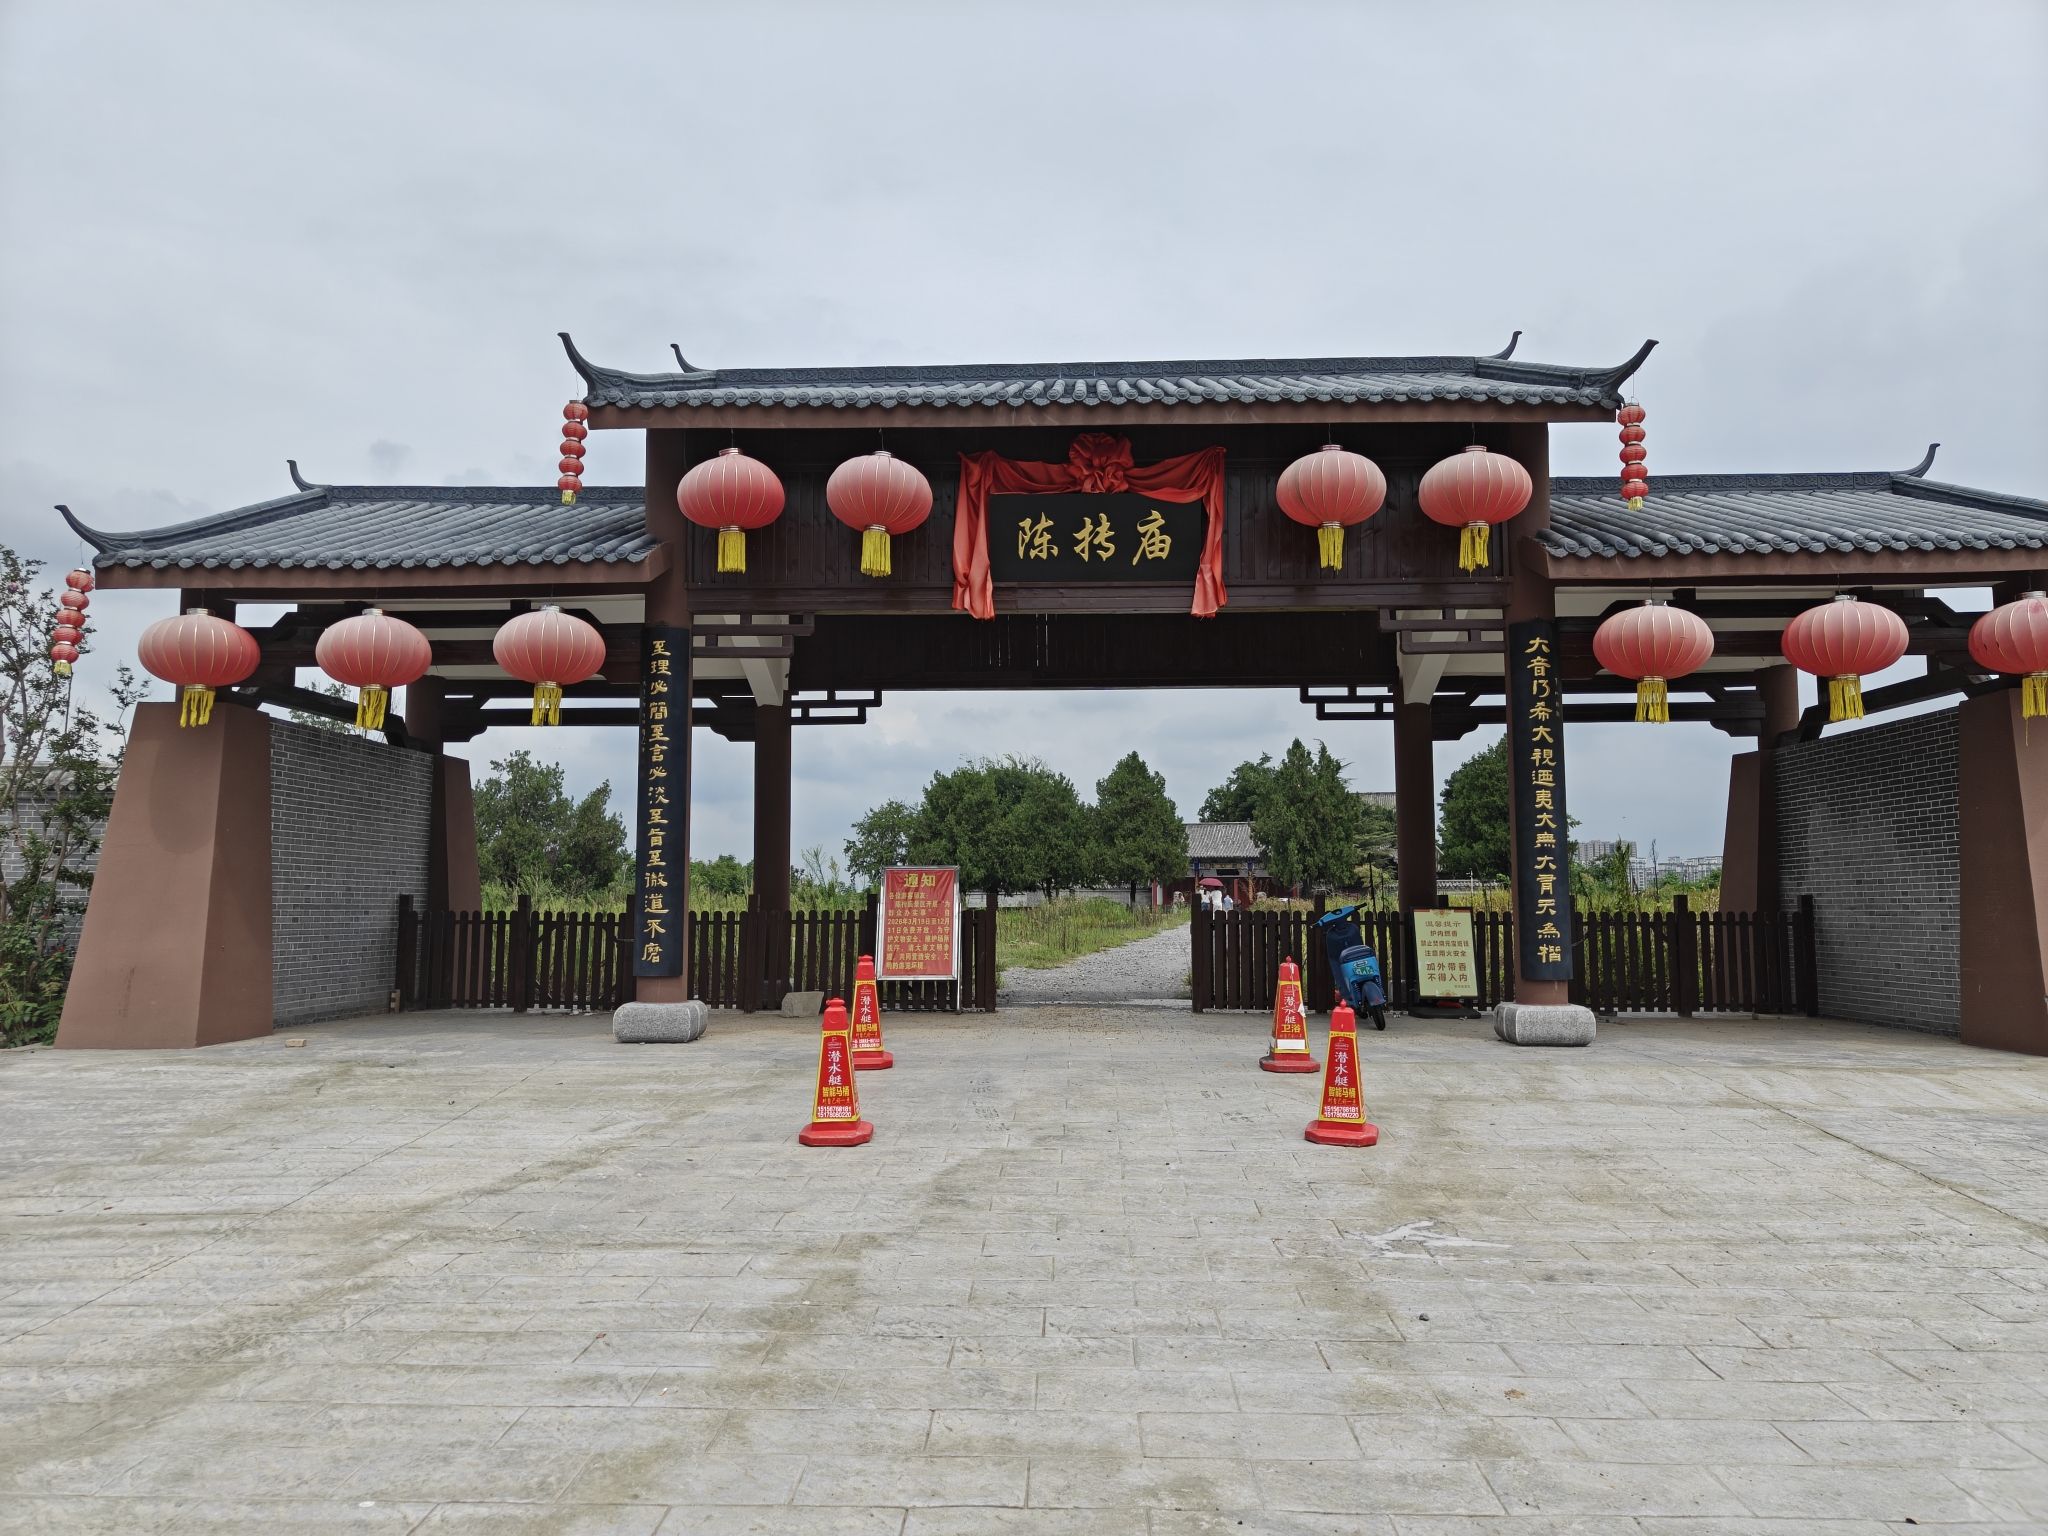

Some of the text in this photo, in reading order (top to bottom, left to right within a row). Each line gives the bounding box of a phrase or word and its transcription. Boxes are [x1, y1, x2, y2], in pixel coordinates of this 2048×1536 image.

[903, 873, 936, 888] 通知
[1424, 920, 1462, 928] 温馨提示
[1427, 973, 1468, 982] 不得入内
[860, 995, 873, 1023] 潜水艇
[1281, 1024, 1301, 1033] 卫浴
[827, 1050, 842, 1085] 潜水艇
[1334, 1051, 1349, 1087] 潜水艇
[822, 1085, 850, 1098] 智能马桶
[1328, 1086, 1356, 1099] 智能马桶
